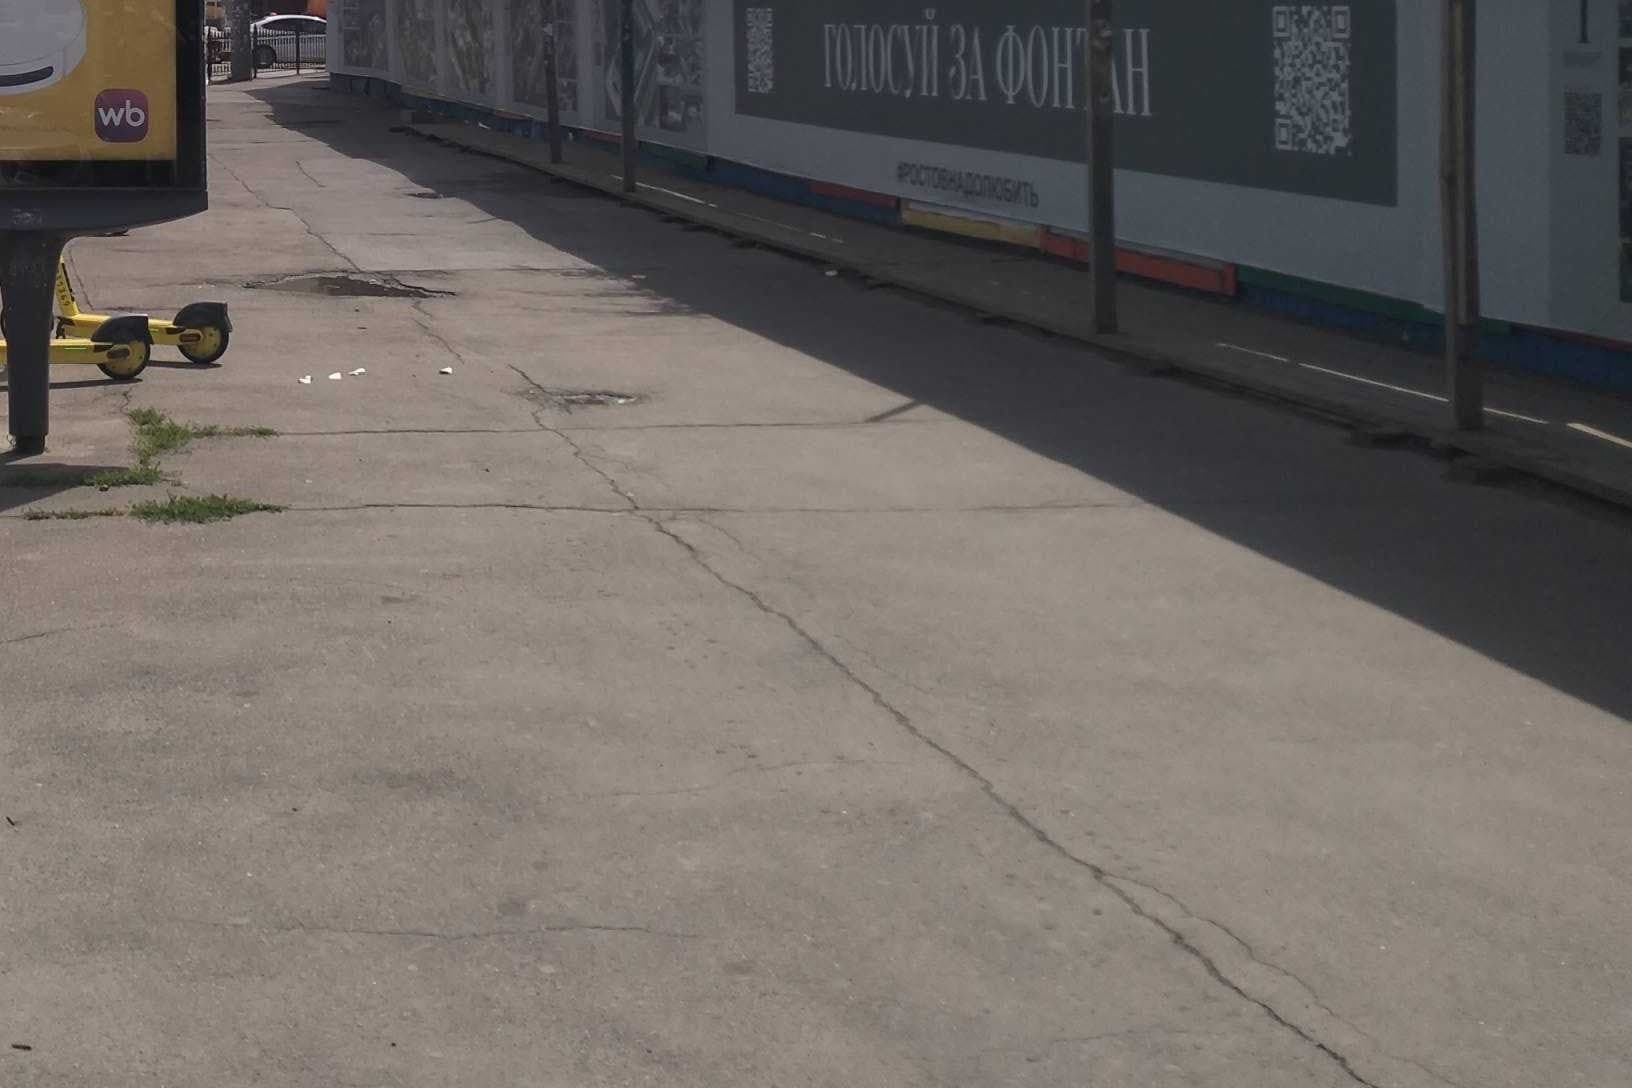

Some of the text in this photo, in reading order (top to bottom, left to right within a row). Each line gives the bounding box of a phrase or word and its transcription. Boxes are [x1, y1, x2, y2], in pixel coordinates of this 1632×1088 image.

[823, 7, 940, 99] ГОЛОСУЙ
[948, 23, 988, 102] ЗА
[97, 99, 145, 128] wb
